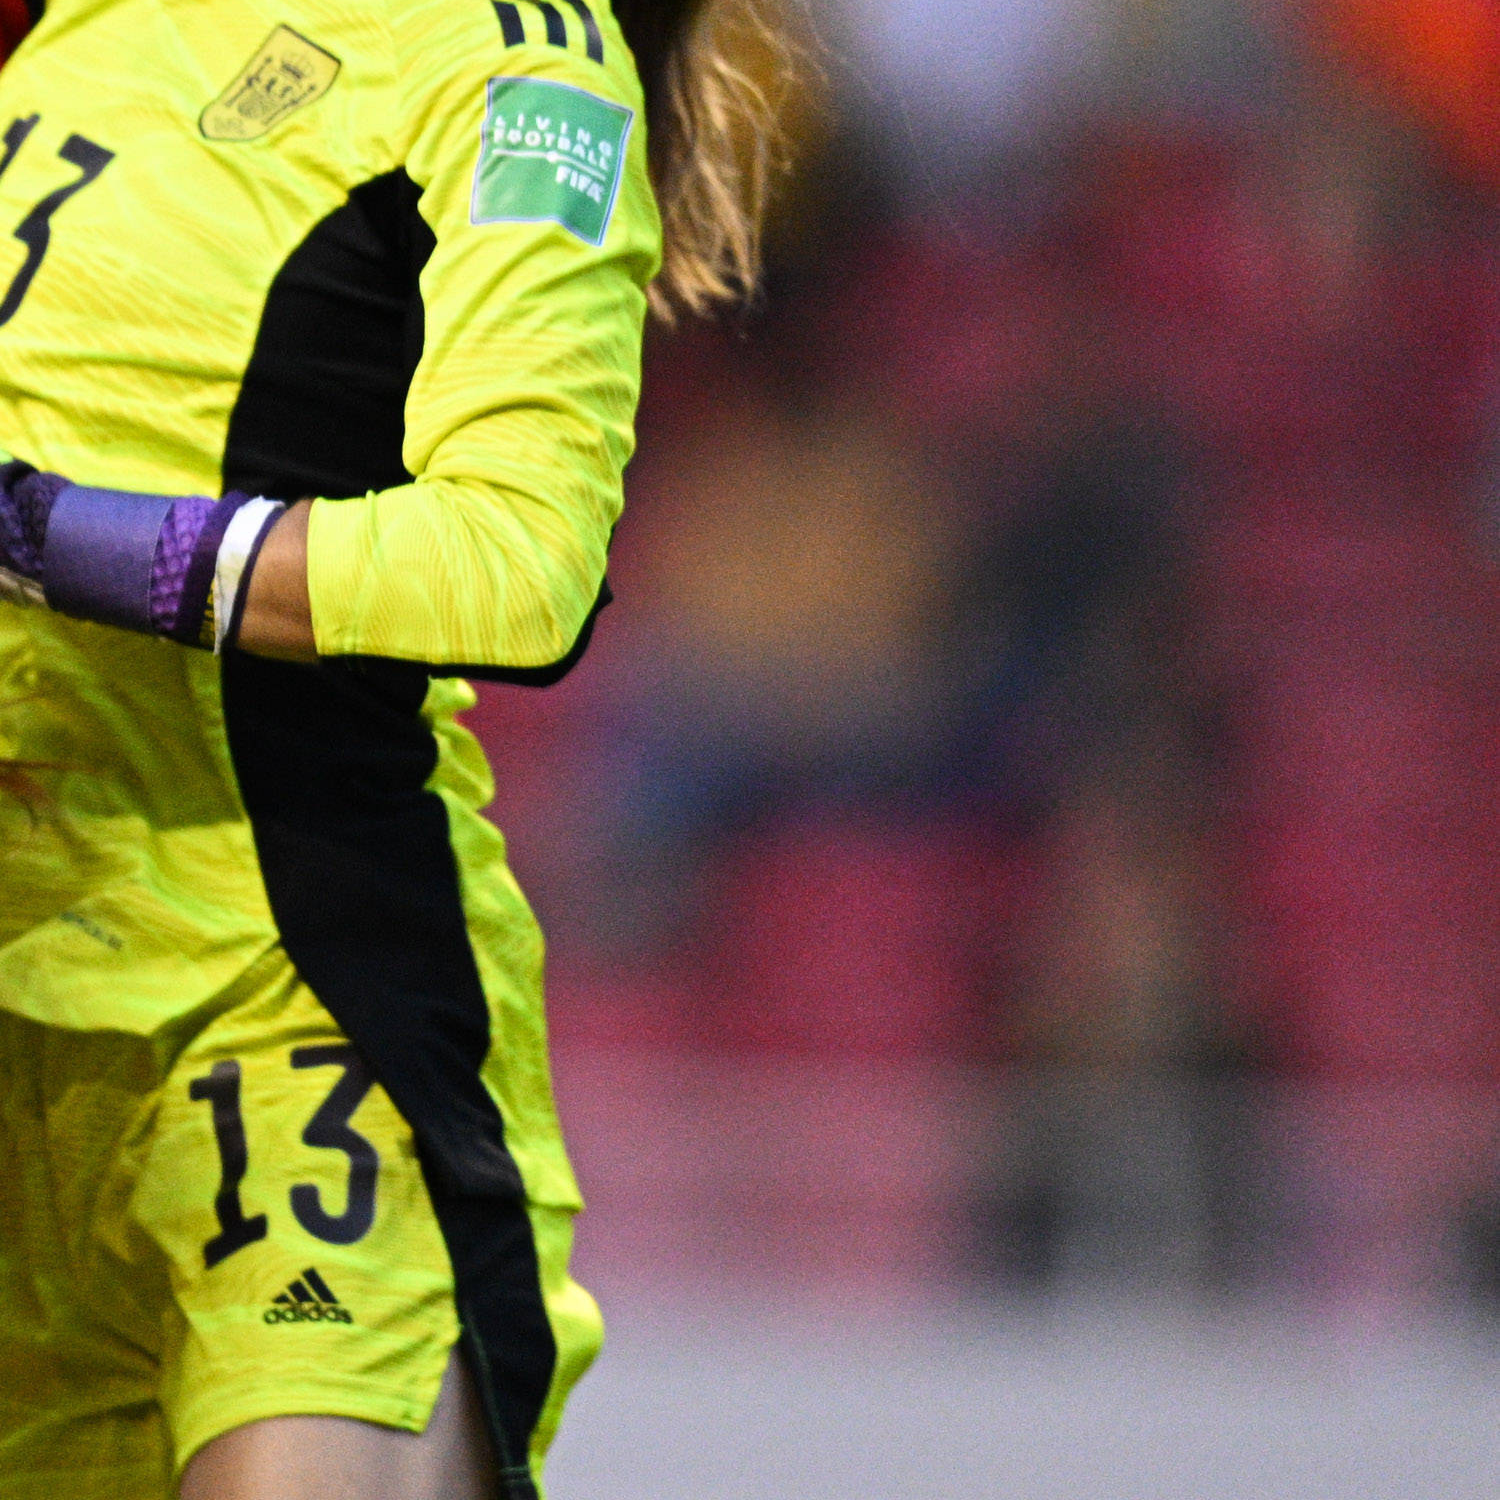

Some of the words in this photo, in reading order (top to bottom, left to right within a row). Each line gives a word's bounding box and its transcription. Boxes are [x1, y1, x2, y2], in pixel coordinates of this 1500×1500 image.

[493, 129, 609, 172] FOOTBALL
[494, 112, 613, 158] LIVING
[555, 164, 606, 204] FIFA
[188, 1045, 381, 1269] 13
[262, 1301, 355, 1325] adidas
